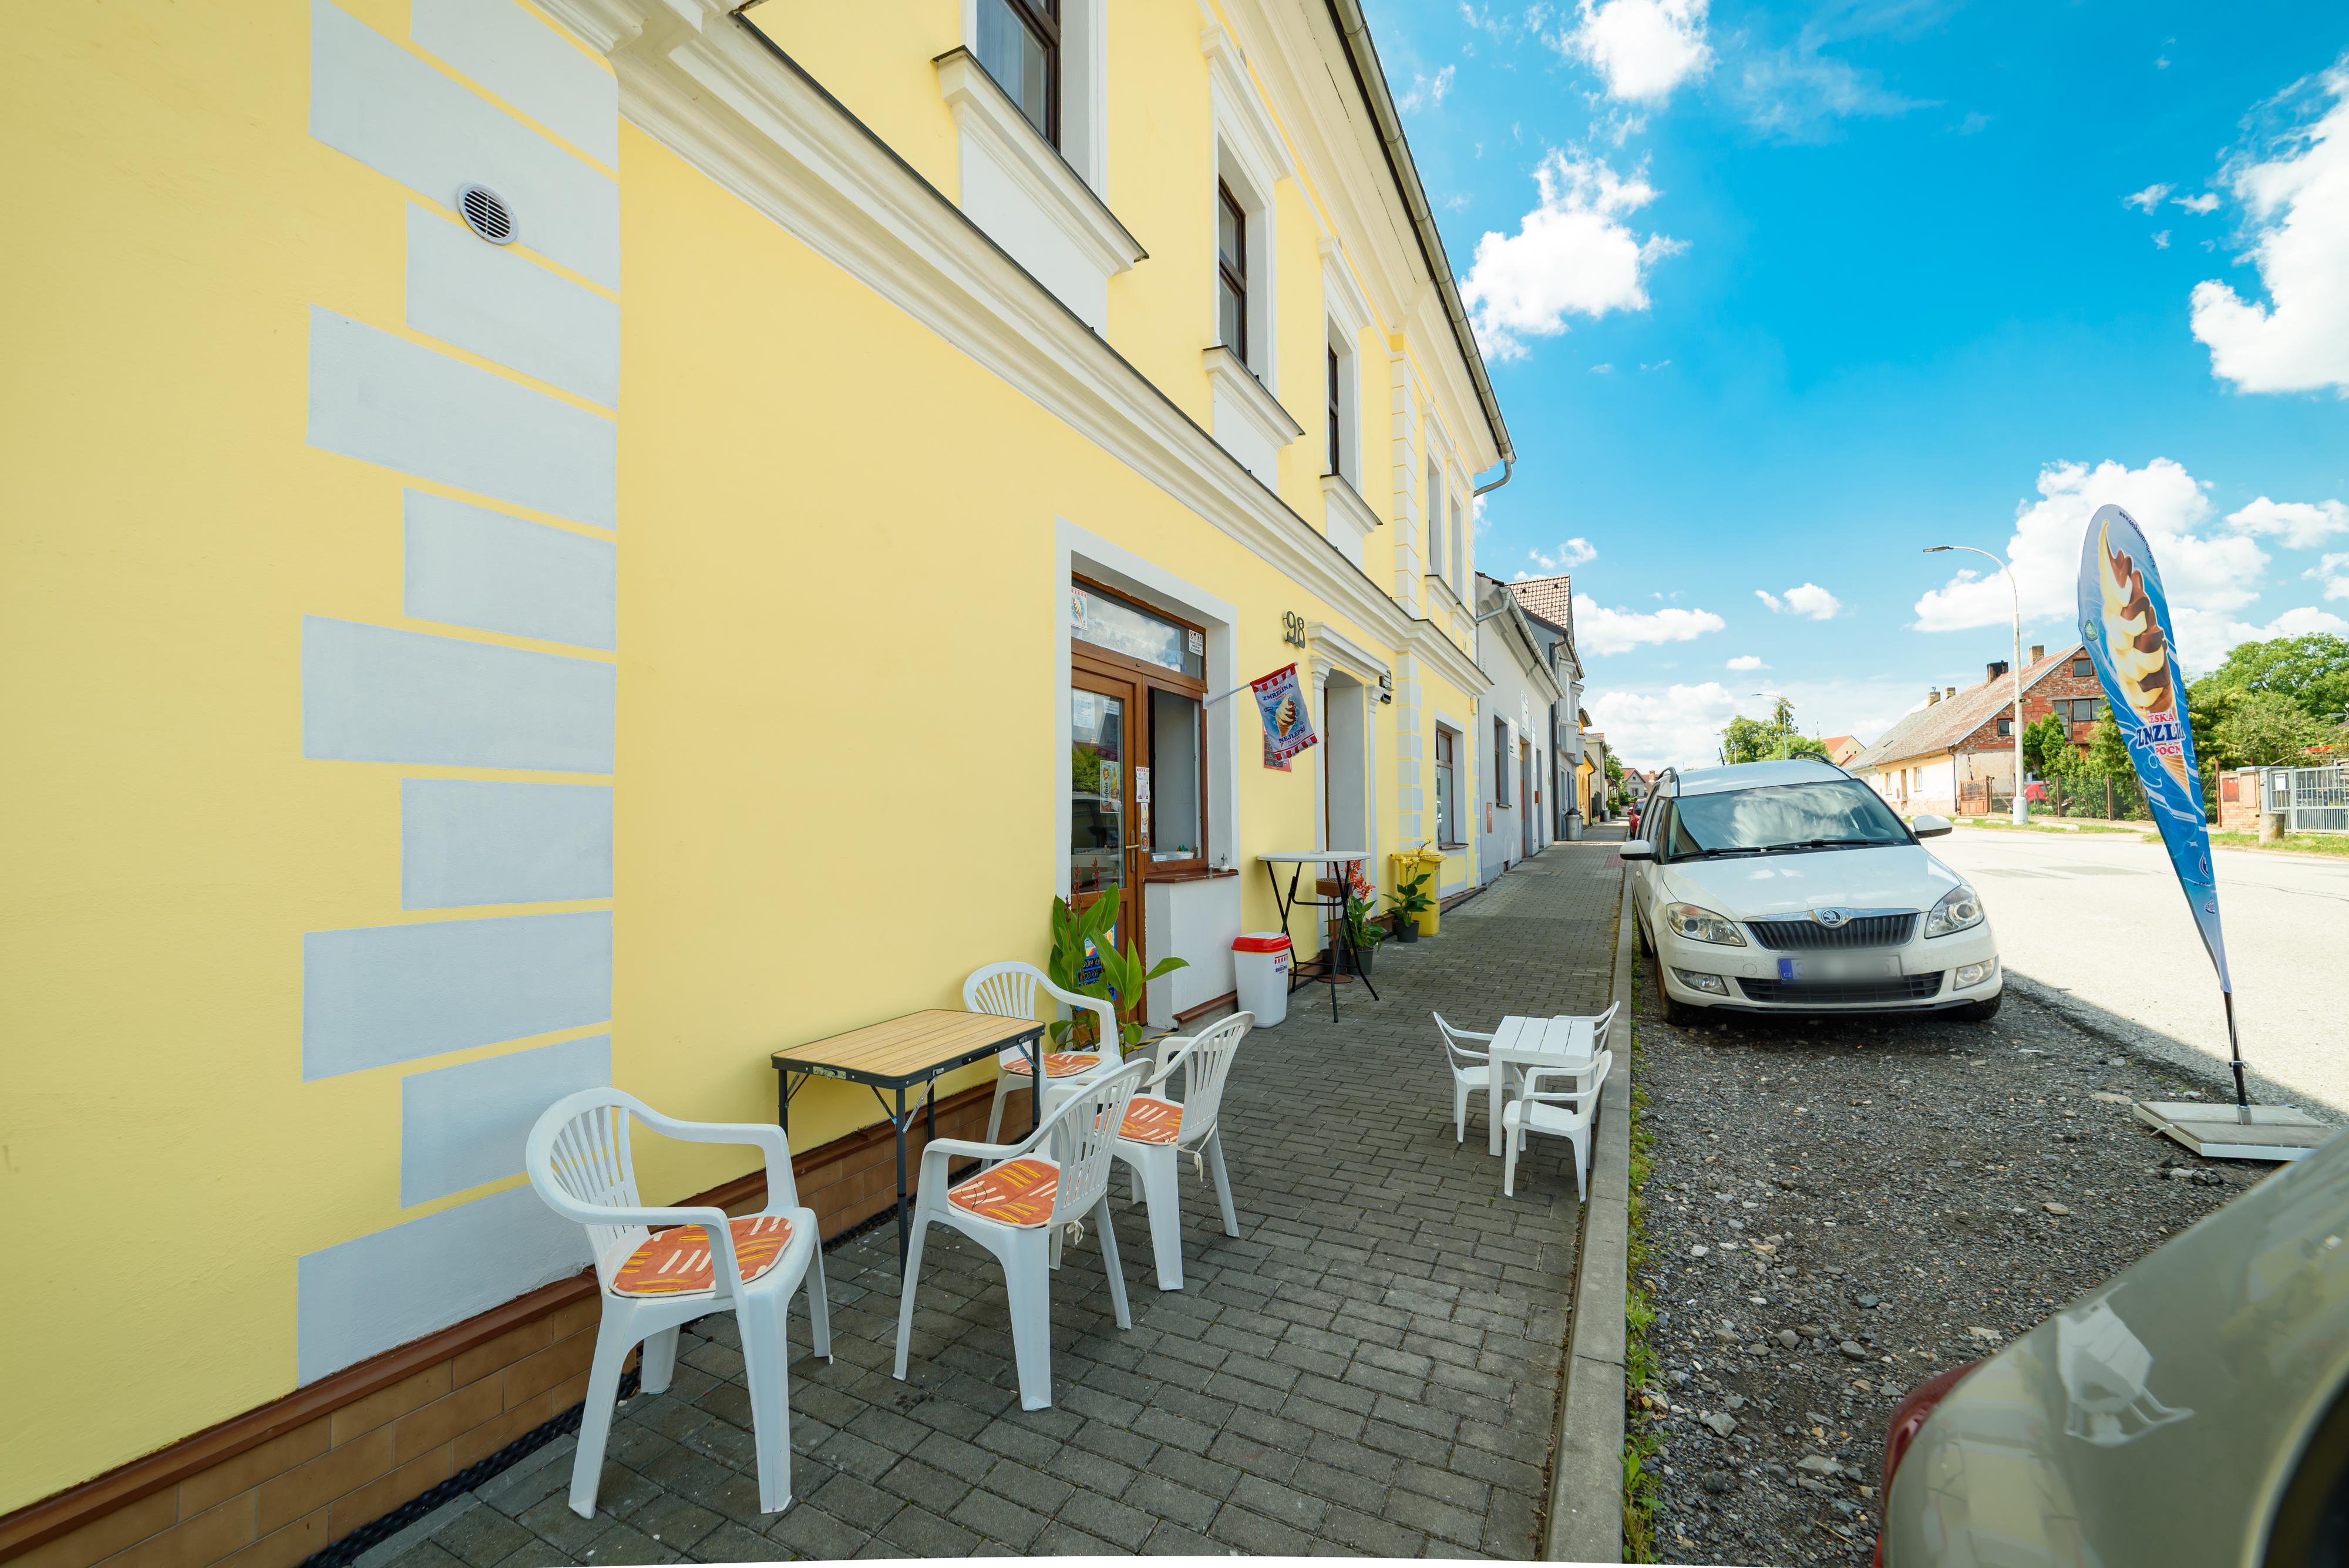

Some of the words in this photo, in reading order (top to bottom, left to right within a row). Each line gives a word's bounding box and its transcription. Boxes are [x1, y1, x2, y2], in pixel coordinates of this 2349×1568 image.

[1286, 611, 1305, 649] 98
[1263, 683, 1293, 701] ZMRZLINA
[2148, 711, 2175, 723] ESKÁ
